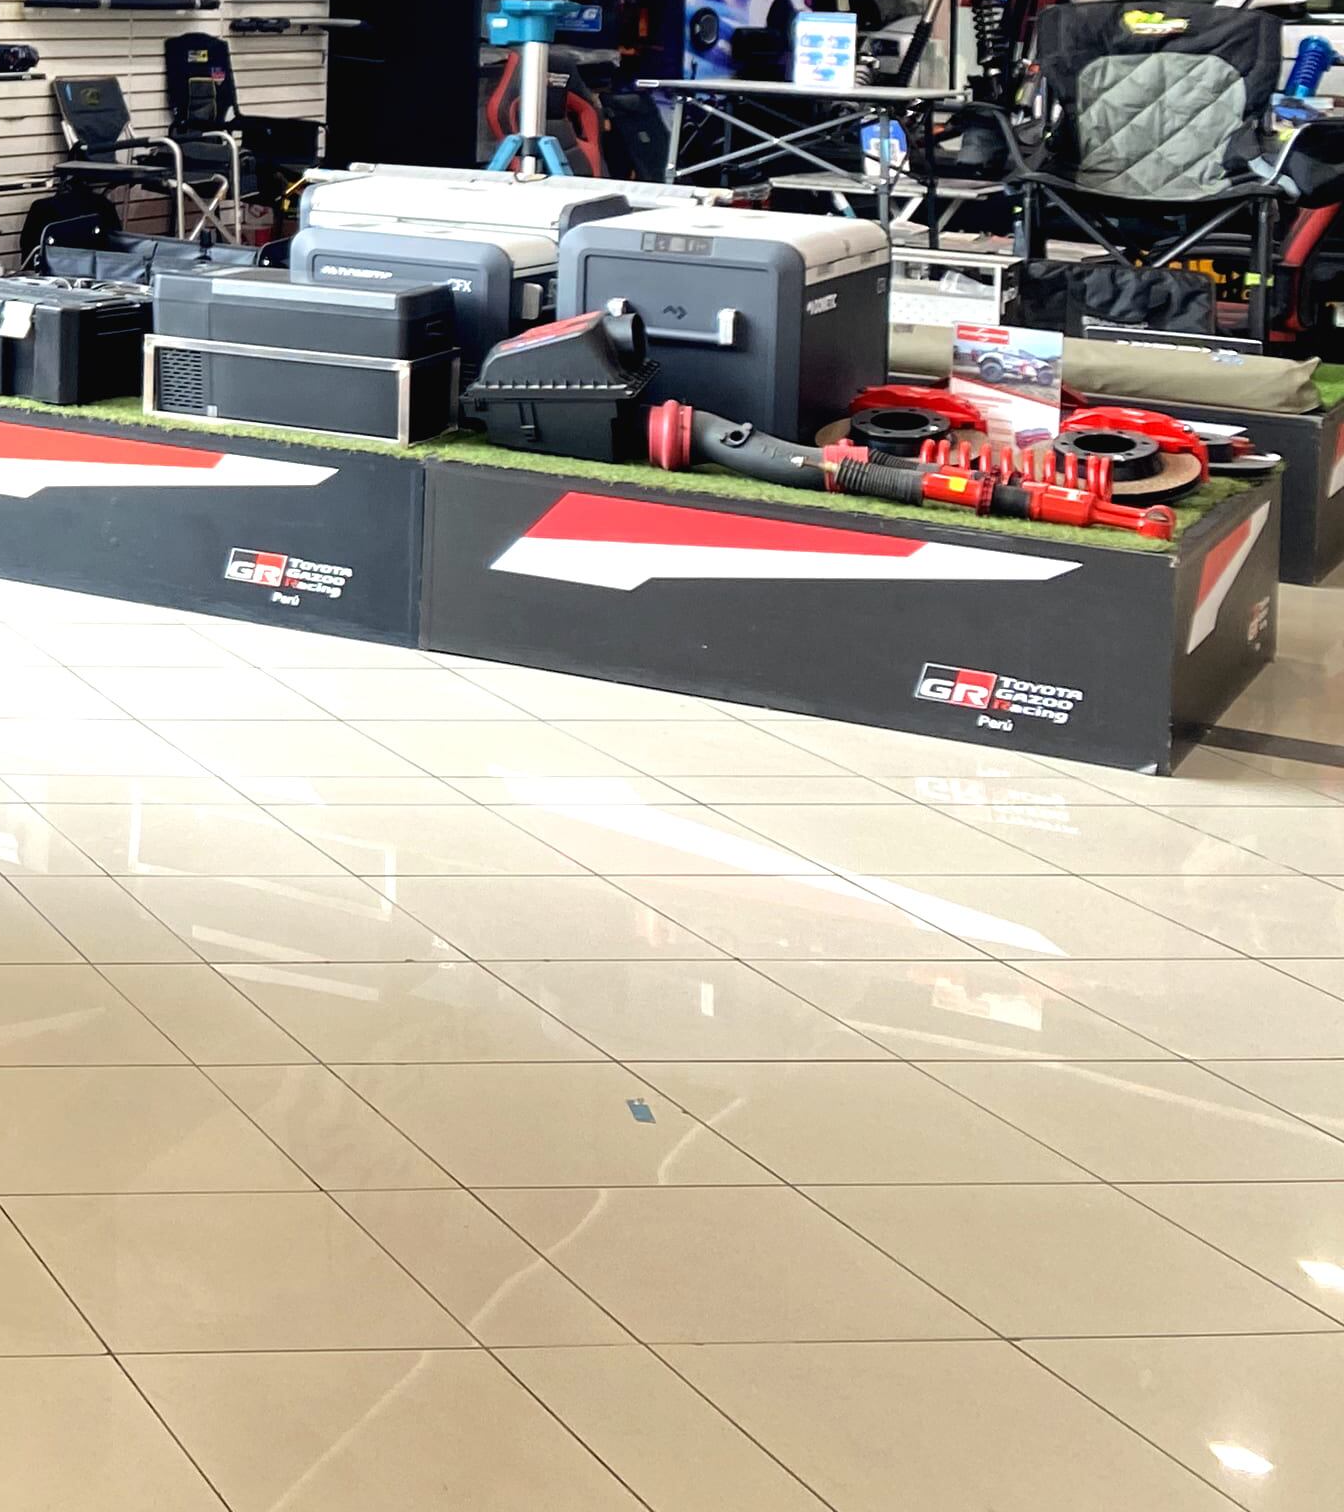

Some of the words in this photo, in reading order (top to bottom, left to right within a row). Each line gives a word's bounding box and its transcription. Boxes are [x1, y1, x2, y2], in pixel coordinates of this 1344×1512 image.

[227, 560, 282, 586] GR
[289, 557, 353, 578] TOYOTA
[286, 568, 346, 587] GAZOO
[284, 577, 343, 599] Racing
[919, 678, 989, 706] GR
[999, 676, 1084, 701] TOYOTA
[995, 688, 1074, 711] GAZOO
[977, 714, 1014, 733] Perú
[992, 699, 1069, 725] Racing
